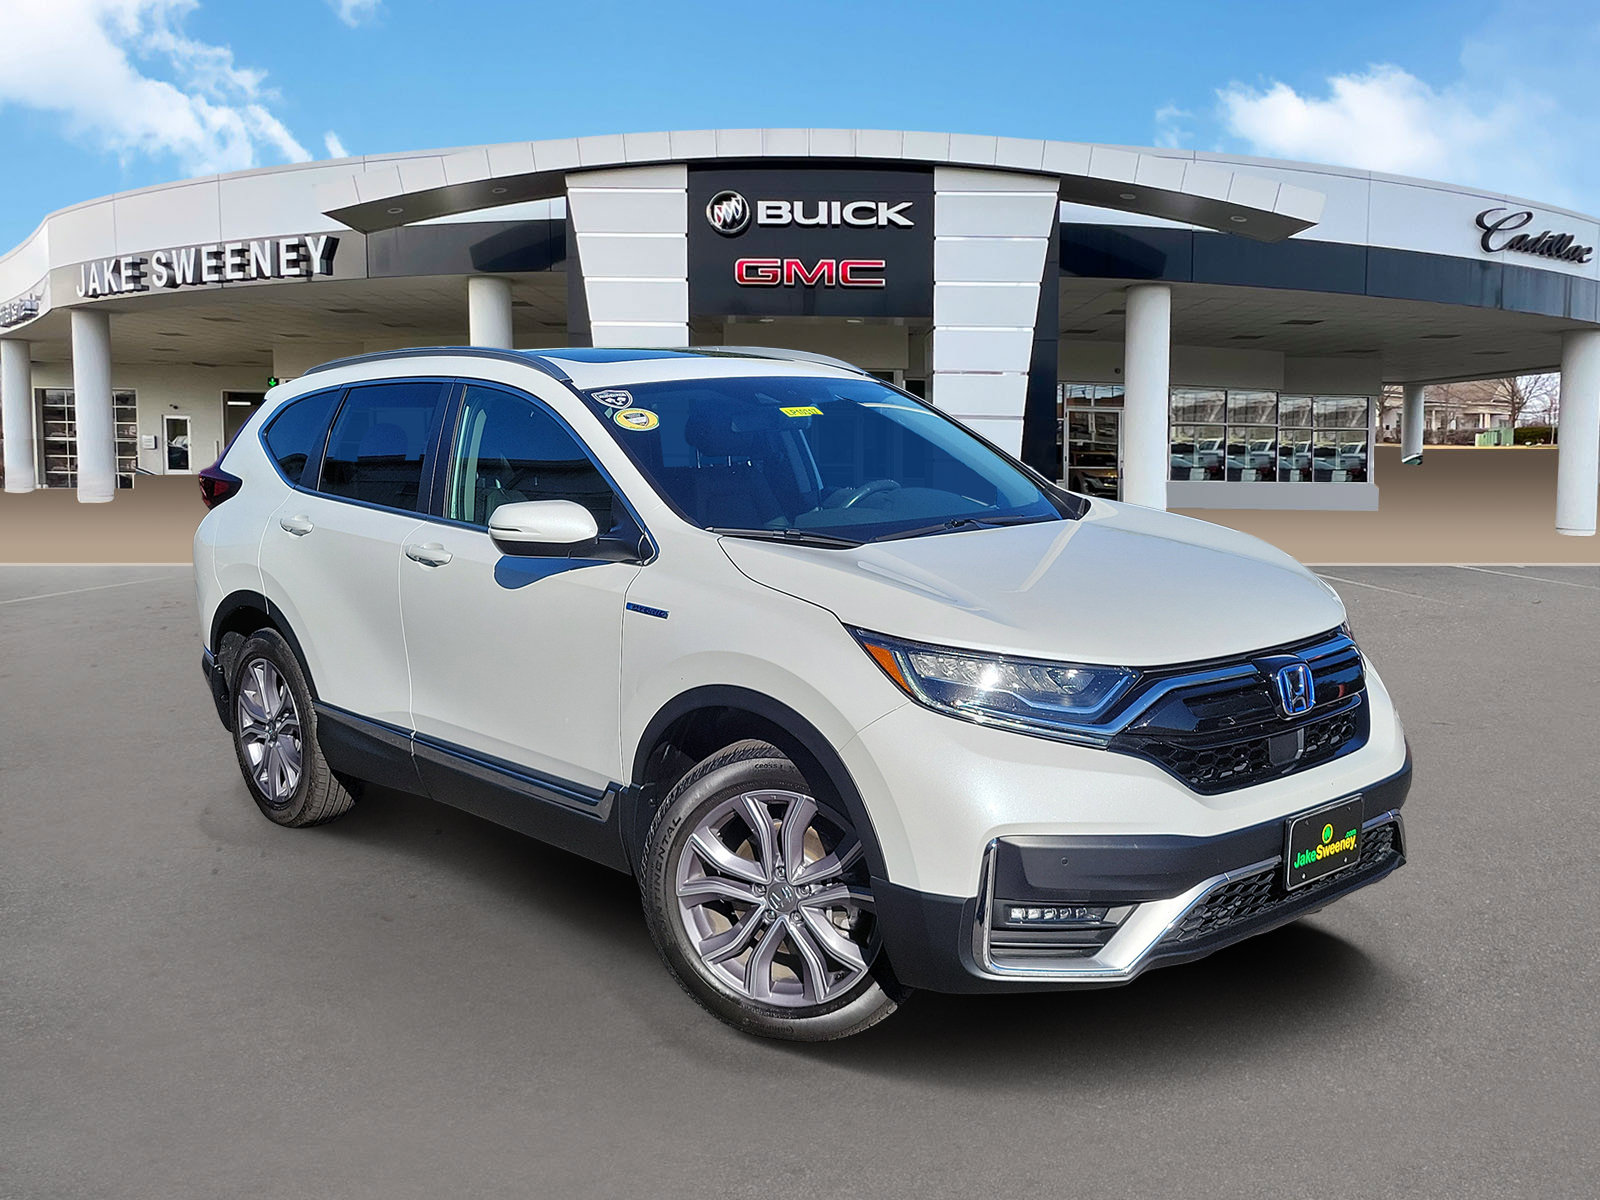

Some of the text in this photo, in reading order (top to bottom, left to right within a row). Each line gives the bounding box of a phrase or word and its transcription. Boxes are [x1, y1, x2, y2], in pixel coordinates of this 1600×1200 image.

[757, 201, 915, 227] BUICK
[1475, 207, 1593, 264] Cadillac
[76, 234, 334, 298] JAKE SWEENEY
[734, 258, 886, 287] GMC
